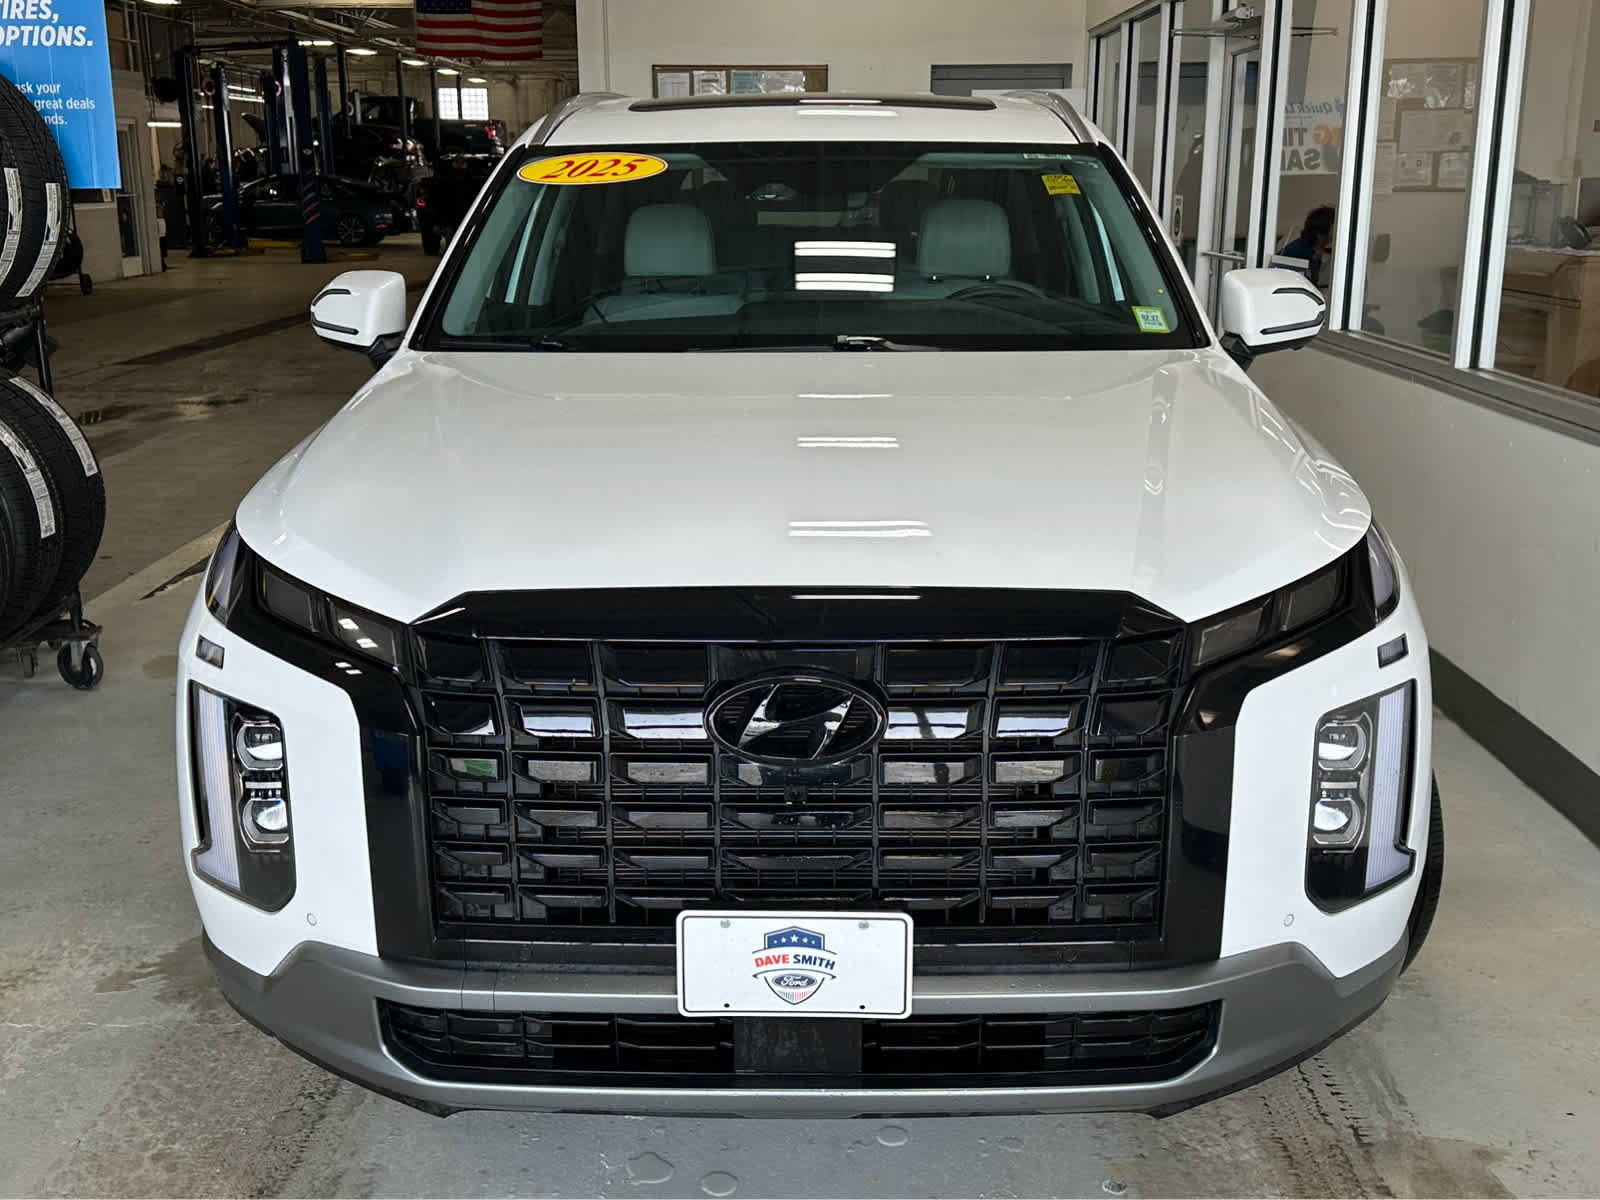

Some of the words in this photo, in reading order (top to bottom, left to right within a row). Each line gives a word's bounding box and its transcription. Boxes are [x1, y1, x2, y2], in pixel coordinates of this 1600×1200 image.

[36, 83, 62, 96] your
[34, 97, 63, 112] great
[66, 97, 96, 110] deals
[541, 158, 648, 179] 2025
[754, 954, 790, 968] DAVE
[793, 954, 836, 971] SMITH
[780, 976, 809, 987] Ford
